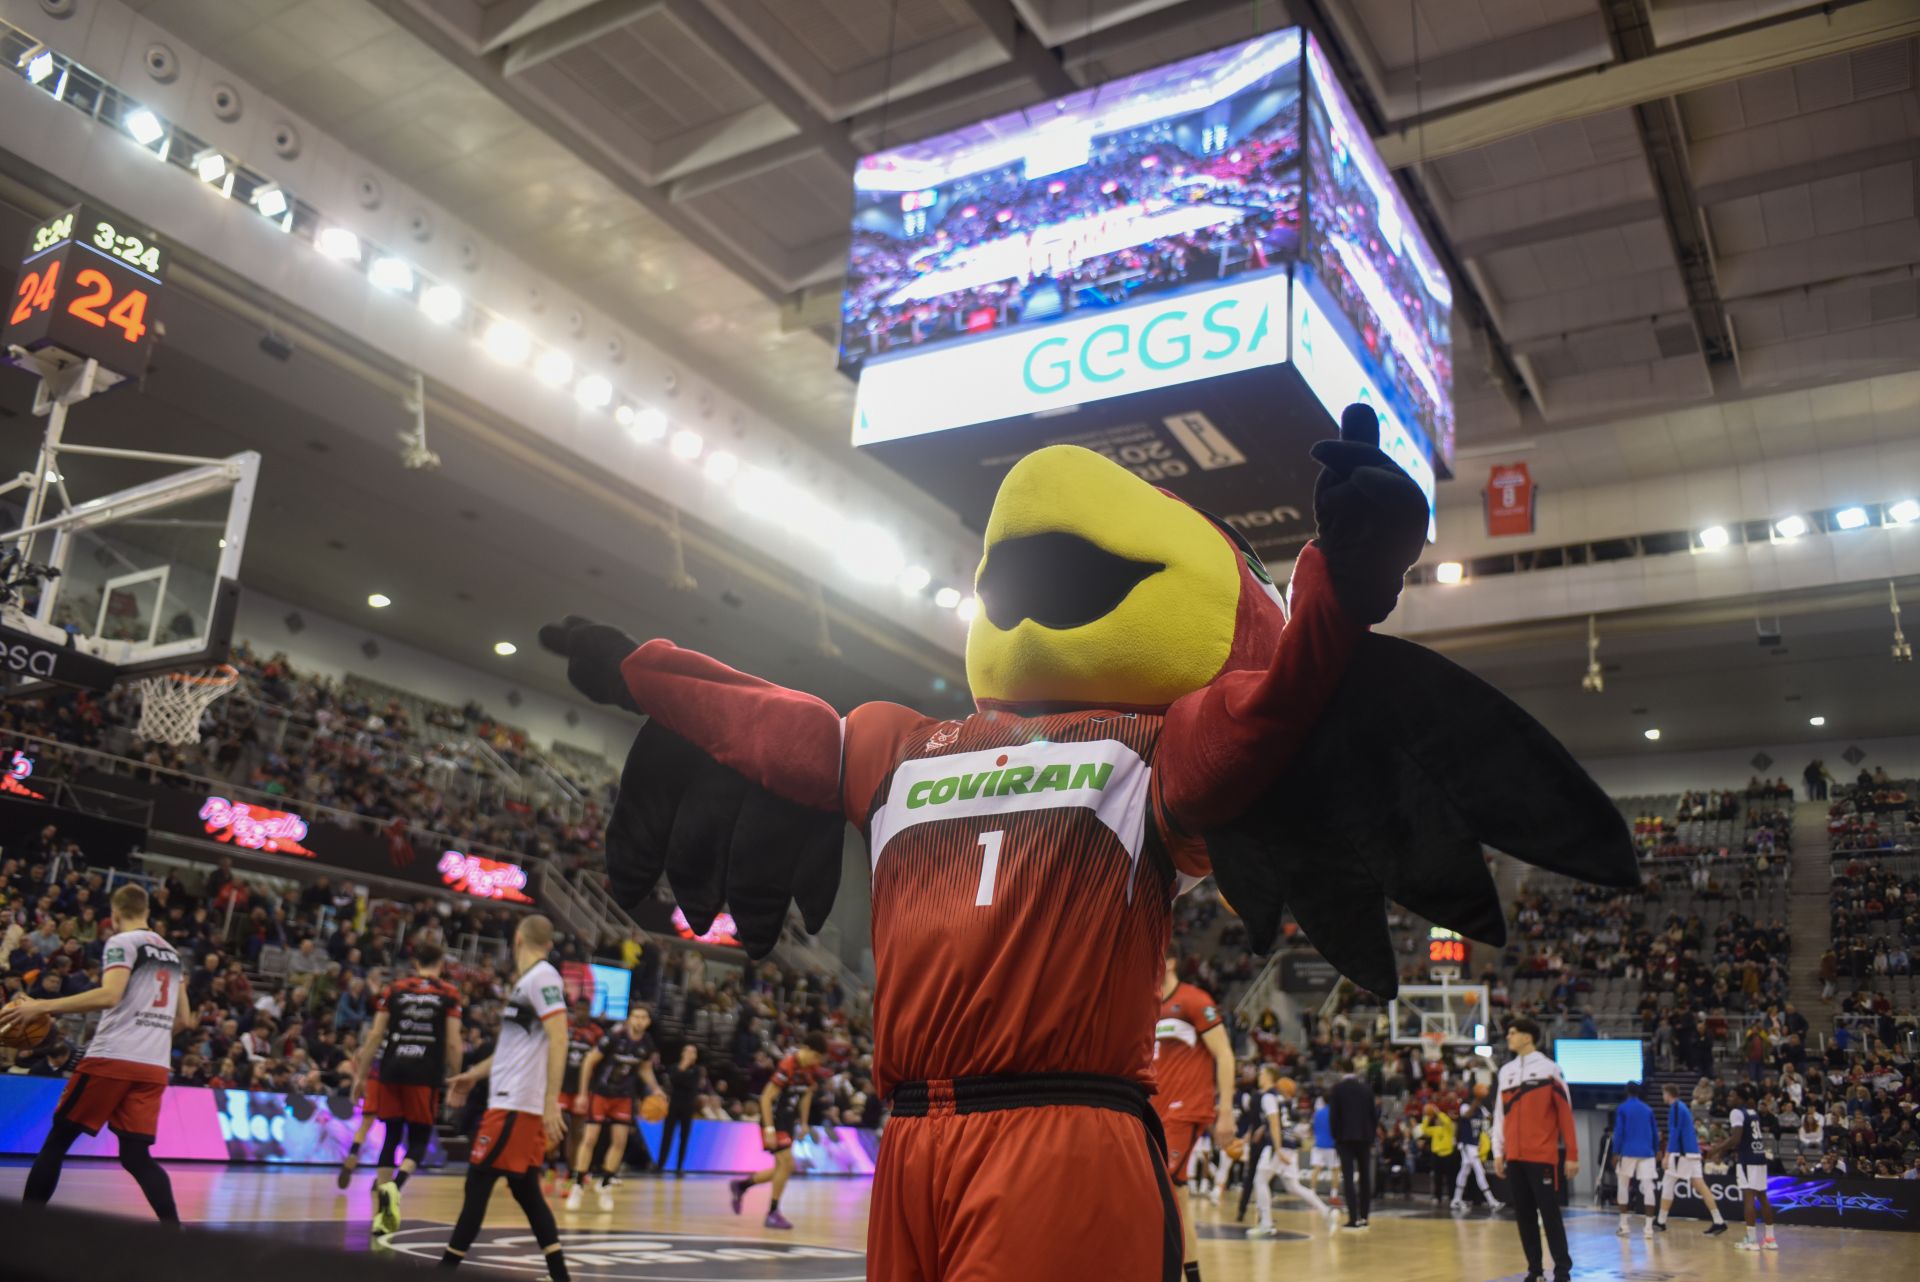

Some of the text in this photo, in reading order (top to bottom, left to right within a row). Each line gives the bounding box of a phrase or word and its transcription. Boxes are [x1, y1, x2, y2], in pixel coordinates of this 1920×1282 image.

[93, 222, 160, 274] 3:24
[10, 261, 60, 325] 24
[68, 269, 148, 343] 24
[975, 830, 1004, 907] 1
[152, 970, 171, 1007] 3
